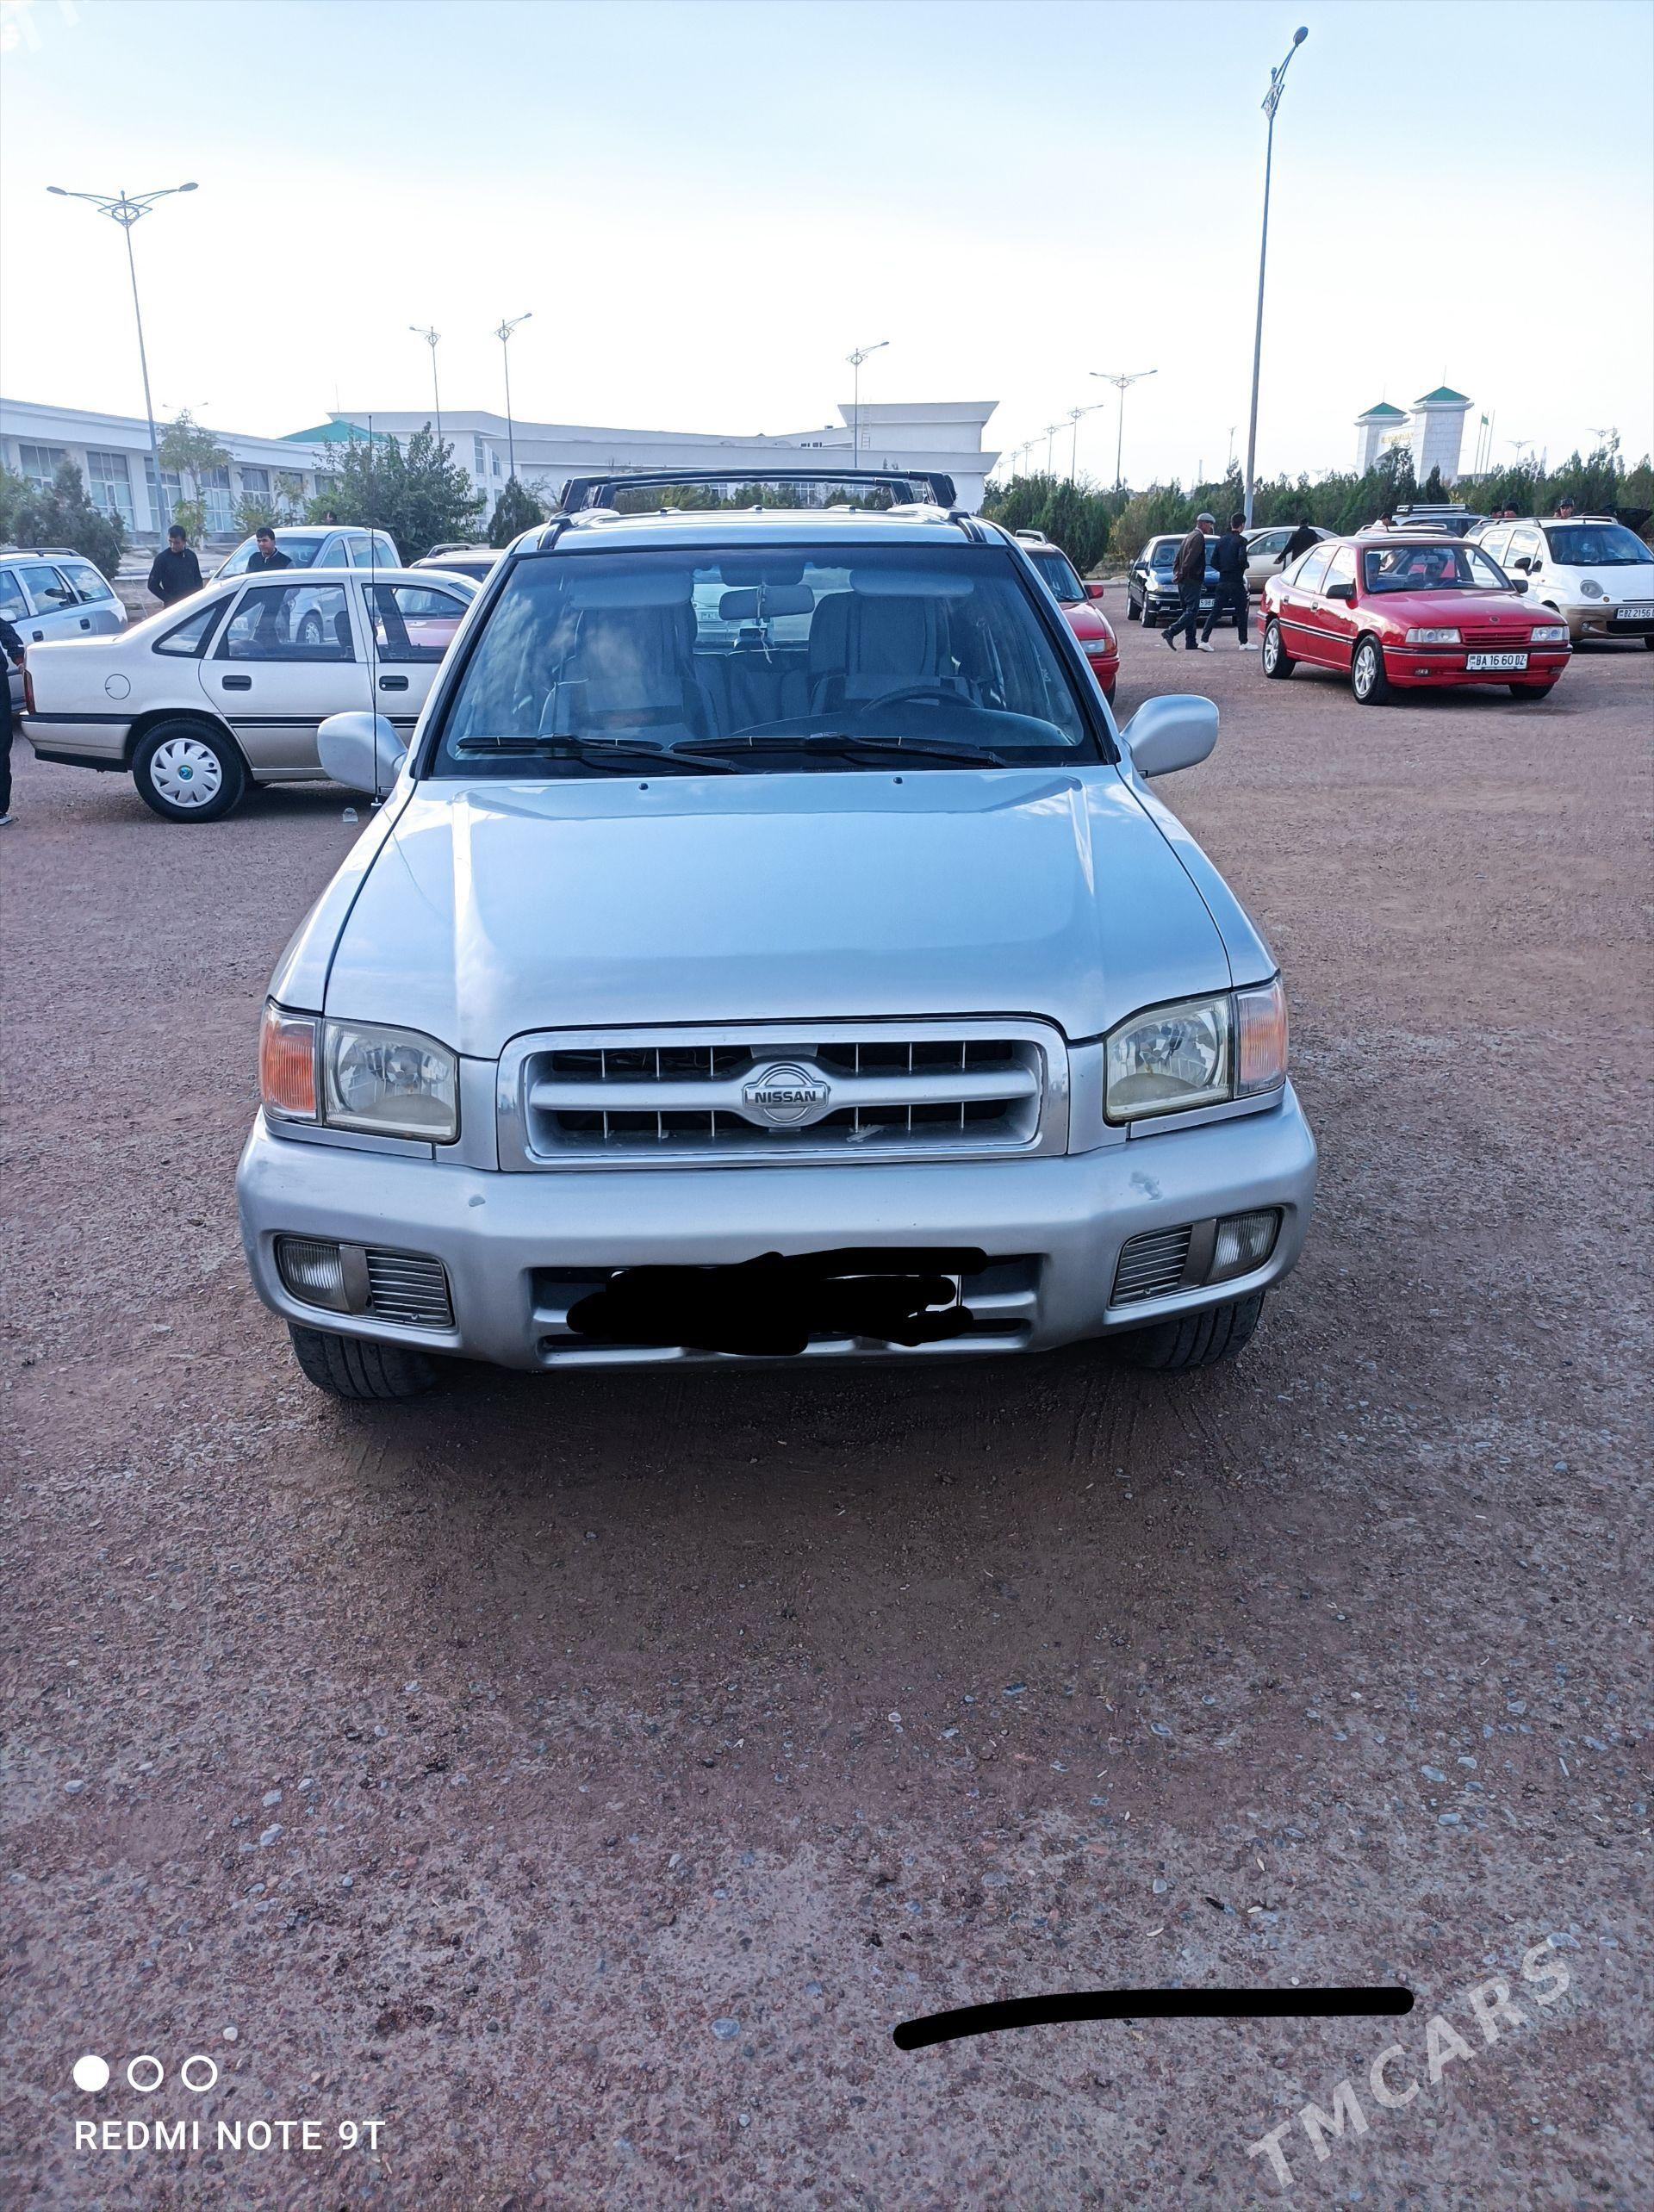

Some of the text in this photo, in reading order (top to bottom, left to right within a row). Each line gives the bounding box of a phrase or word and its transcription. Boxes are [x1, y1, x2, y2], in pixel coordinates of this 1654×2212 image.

[1476, 655, 1487, 666] BA
[1489, 655, 1500, 666] 16
[1501, 655, 1514, 666] 60
[755, 1090, 817, 1103] NISSAN
